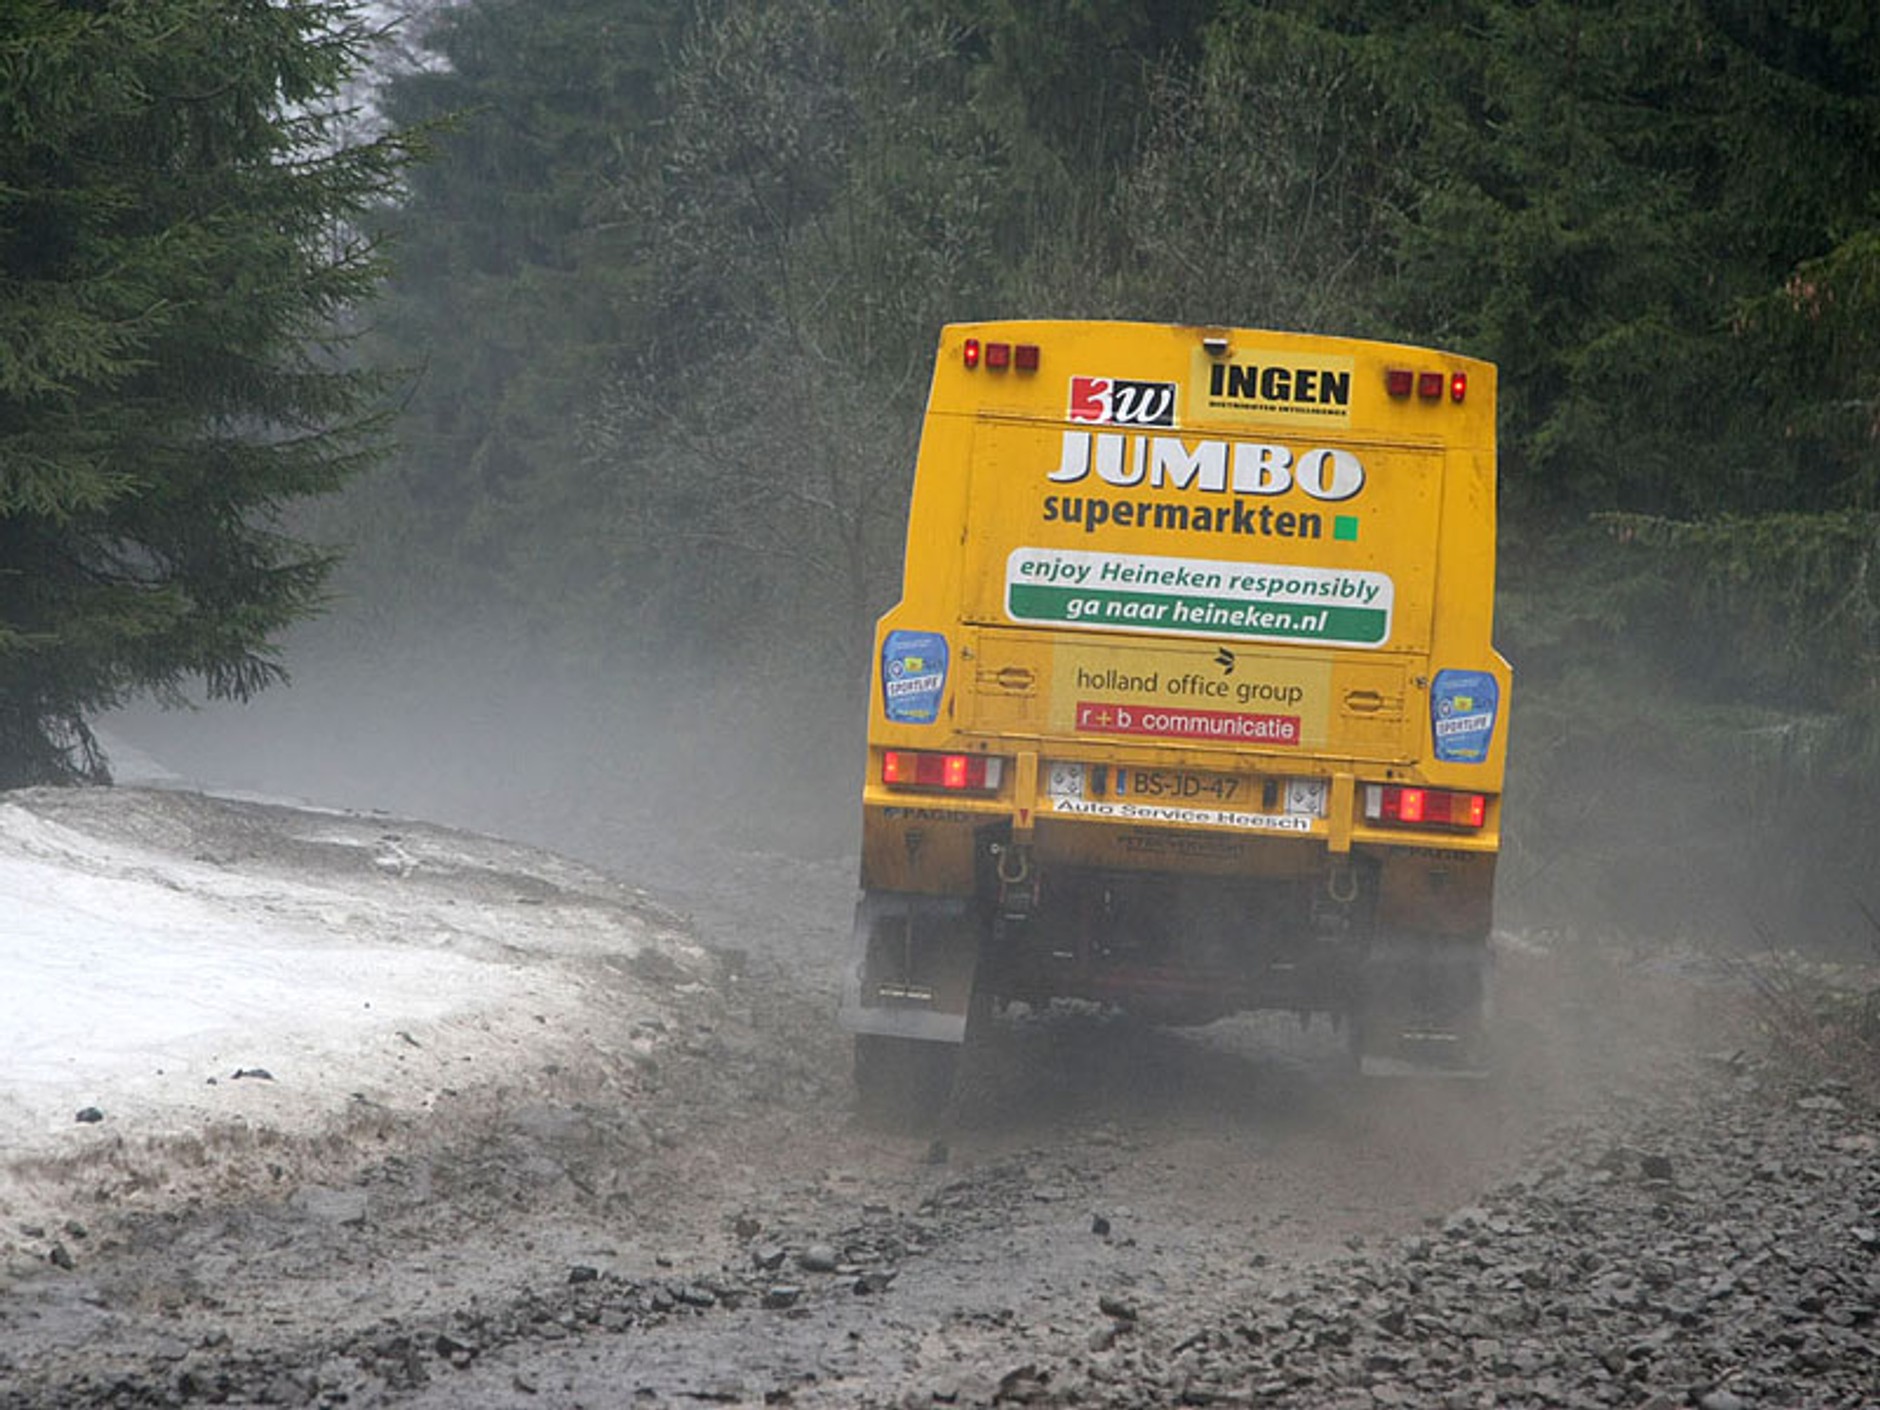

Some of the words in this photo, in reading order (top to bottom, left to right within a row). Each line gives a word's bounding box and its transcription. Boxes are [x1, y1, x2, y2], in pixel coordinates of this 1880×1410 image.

[1210, 364, 1350, 405] INGEN
[1047, 430, 1366, 501] JUMBO
[1043, 496, 1322, 539] supermarkten
[1020, 558, 1091, 583] enjoy
[1100, 562, 1221, 589] Heineken
[1229, 575, 1380, 604] responsibly
[1066, 597, 1099, 619] ga
[1106, 600, 1167, 619] naar
[1172, 601, 1329, 632] heineken.nl
[1077, 668, 1158, 693] holland
[1166, 673, 1229, 697] office
[1236, 681, 1303, 706] group
[1142, 713, 1295, 740] communicatie
[1134, 771, 1239, 799] BS-JD-47
[1057, 800, 1114, 815] Auto
[1121, 804, 1210, 821] Service
[1217, 812, 1310, 830] Heesch
